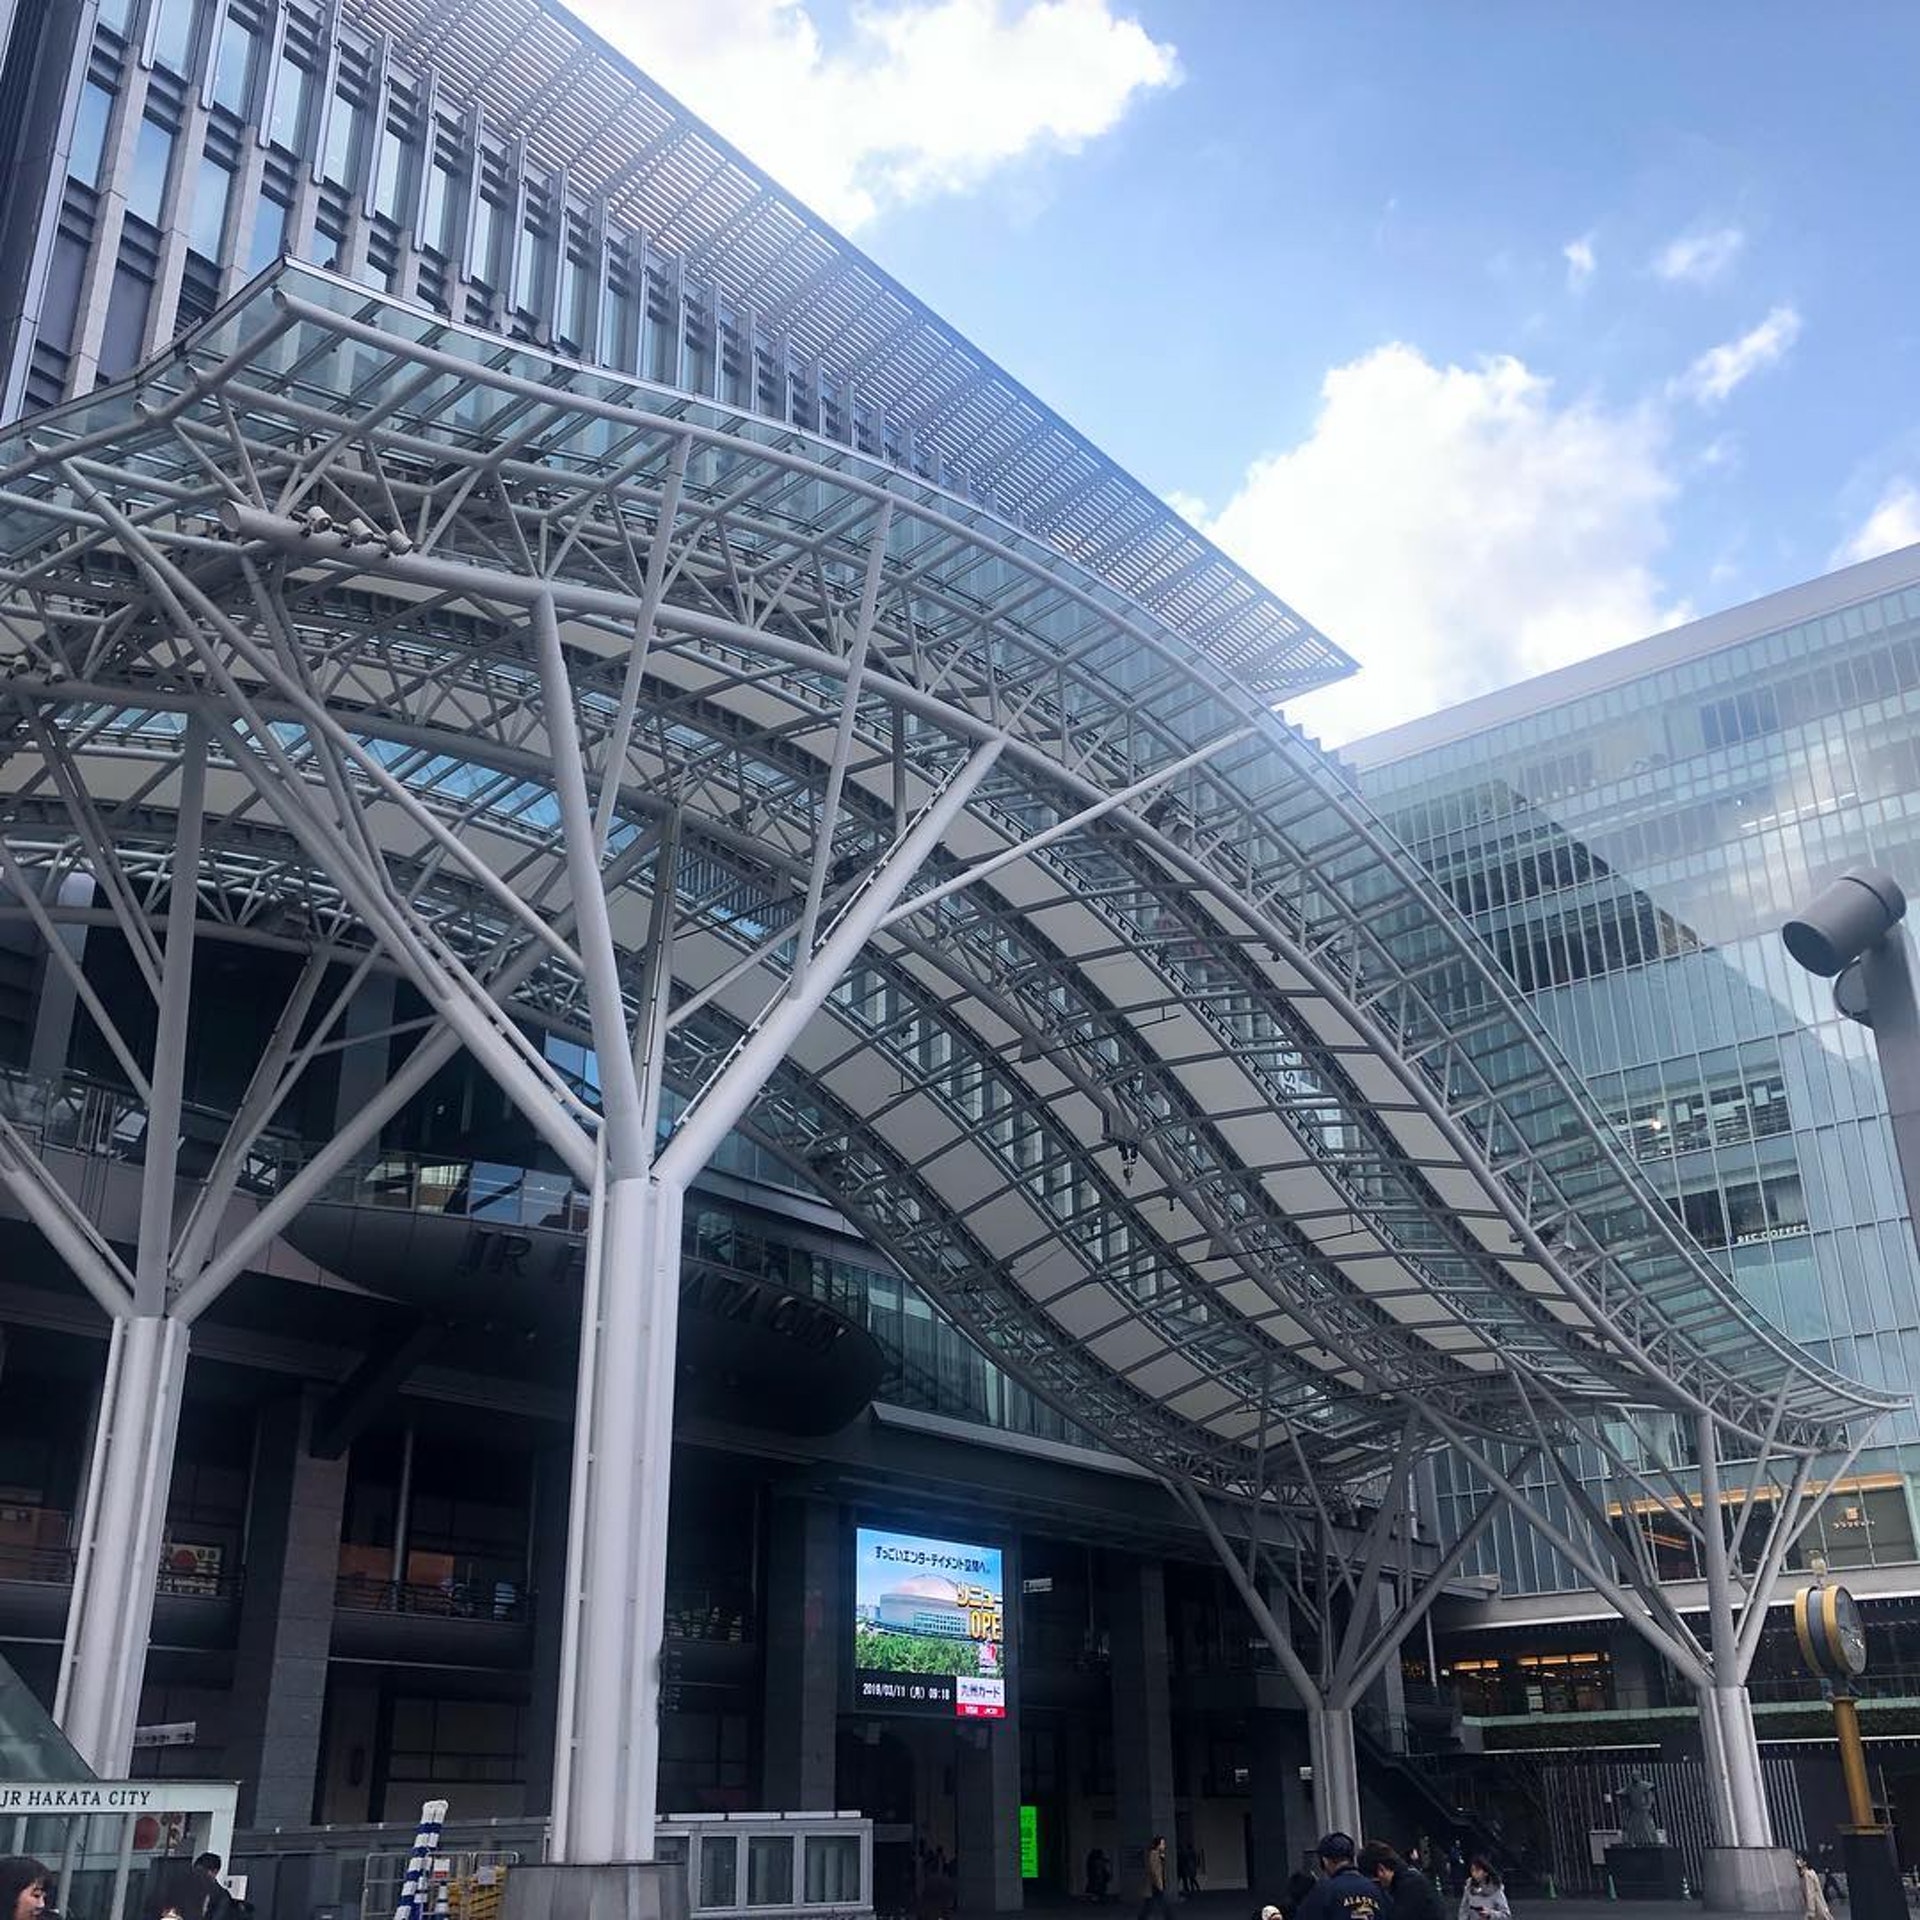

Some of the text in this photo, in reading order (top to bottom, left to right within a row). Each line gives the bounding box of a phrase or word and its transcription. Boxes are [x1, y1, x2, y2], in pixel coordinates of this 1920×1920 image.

[454, 1227, 532, 1278] JR
[0, 1790, 151, 1807] JR HAKATA CITY
